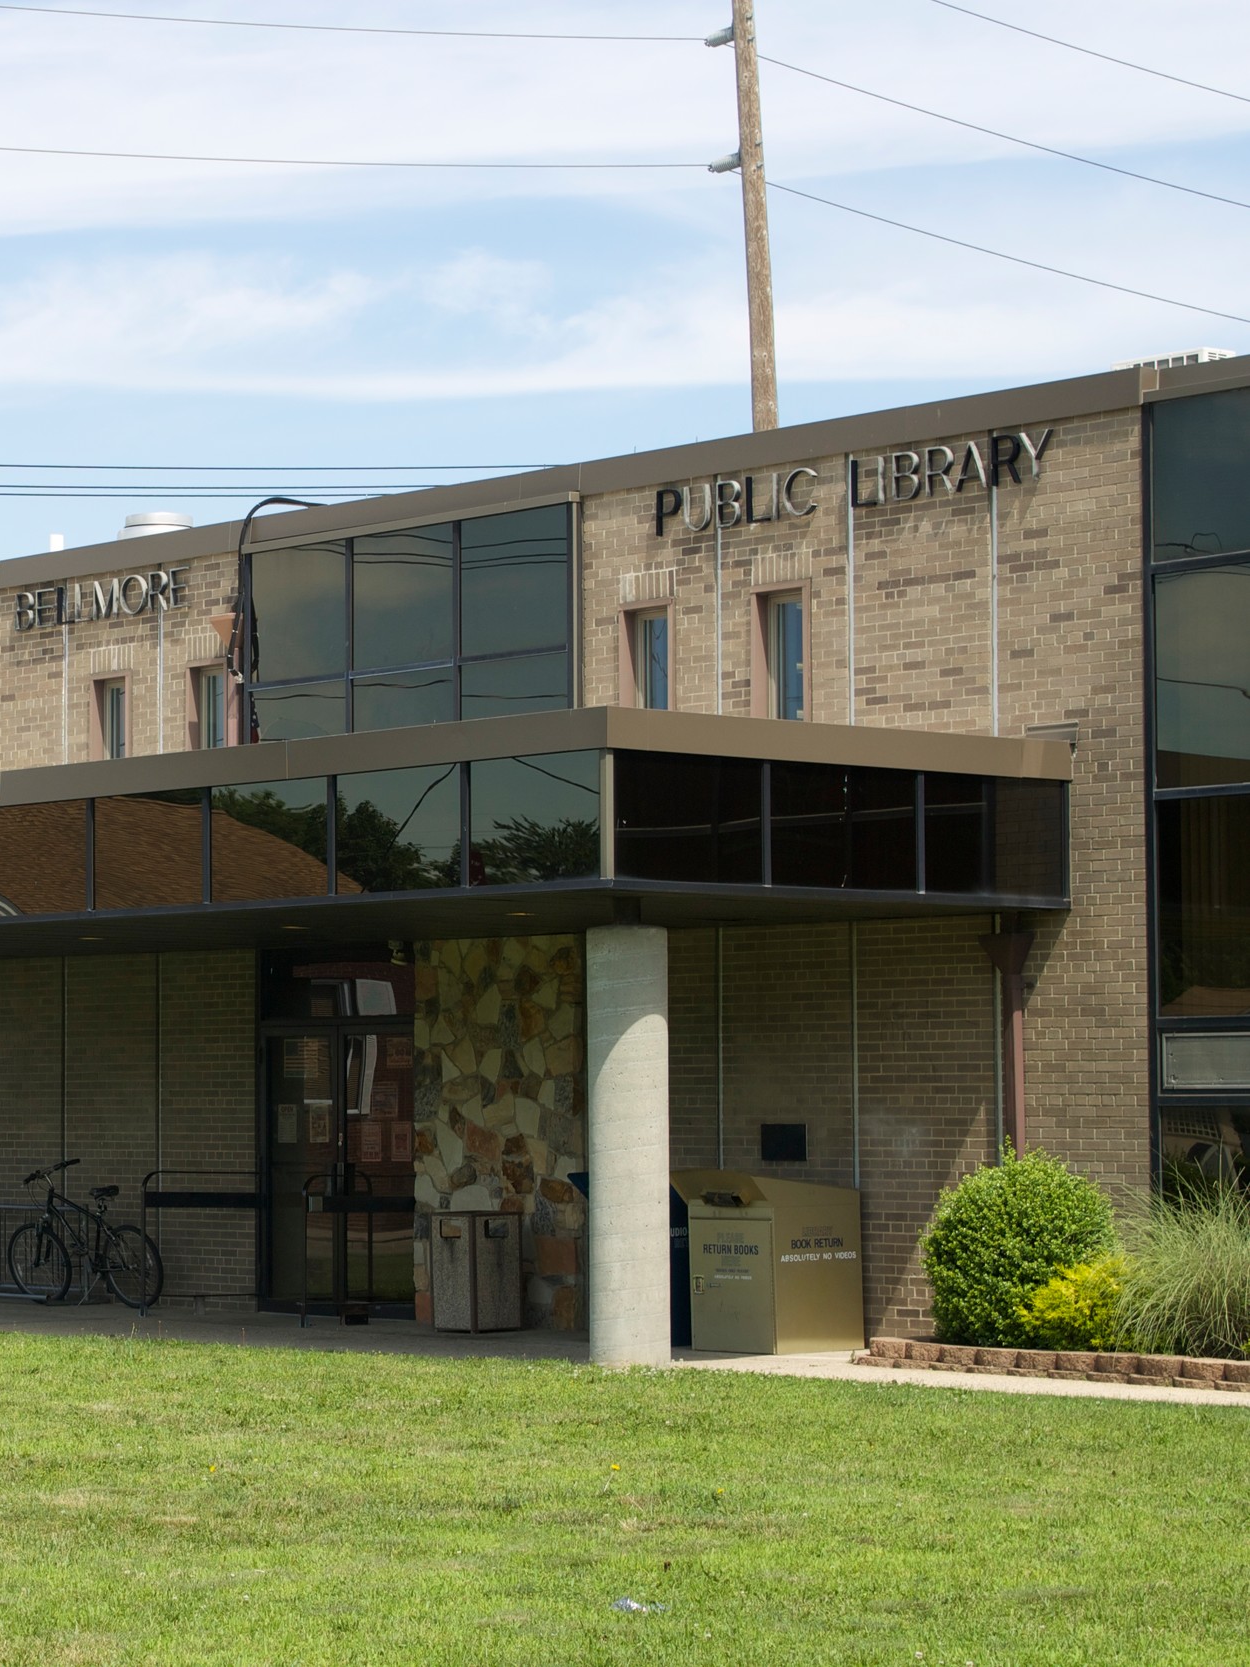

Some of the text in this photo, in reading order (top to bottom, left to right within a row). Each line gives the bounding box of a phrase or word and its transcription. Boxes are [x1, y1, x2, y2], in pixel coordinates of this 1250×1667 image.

[655, 428, 1054, 537] PUBLIC LIBRARY
[14, 566, 190, 631] BELLMORE
[670, 1227, 688, 1237] UDIO
[791, 1237, 843, 1249] BOOK RETURN
[703, 1244, 759, 1255] RETURN BOOKS
[780, 1251, 857, 1263] ABSOLUTELY NO VIDEOS
